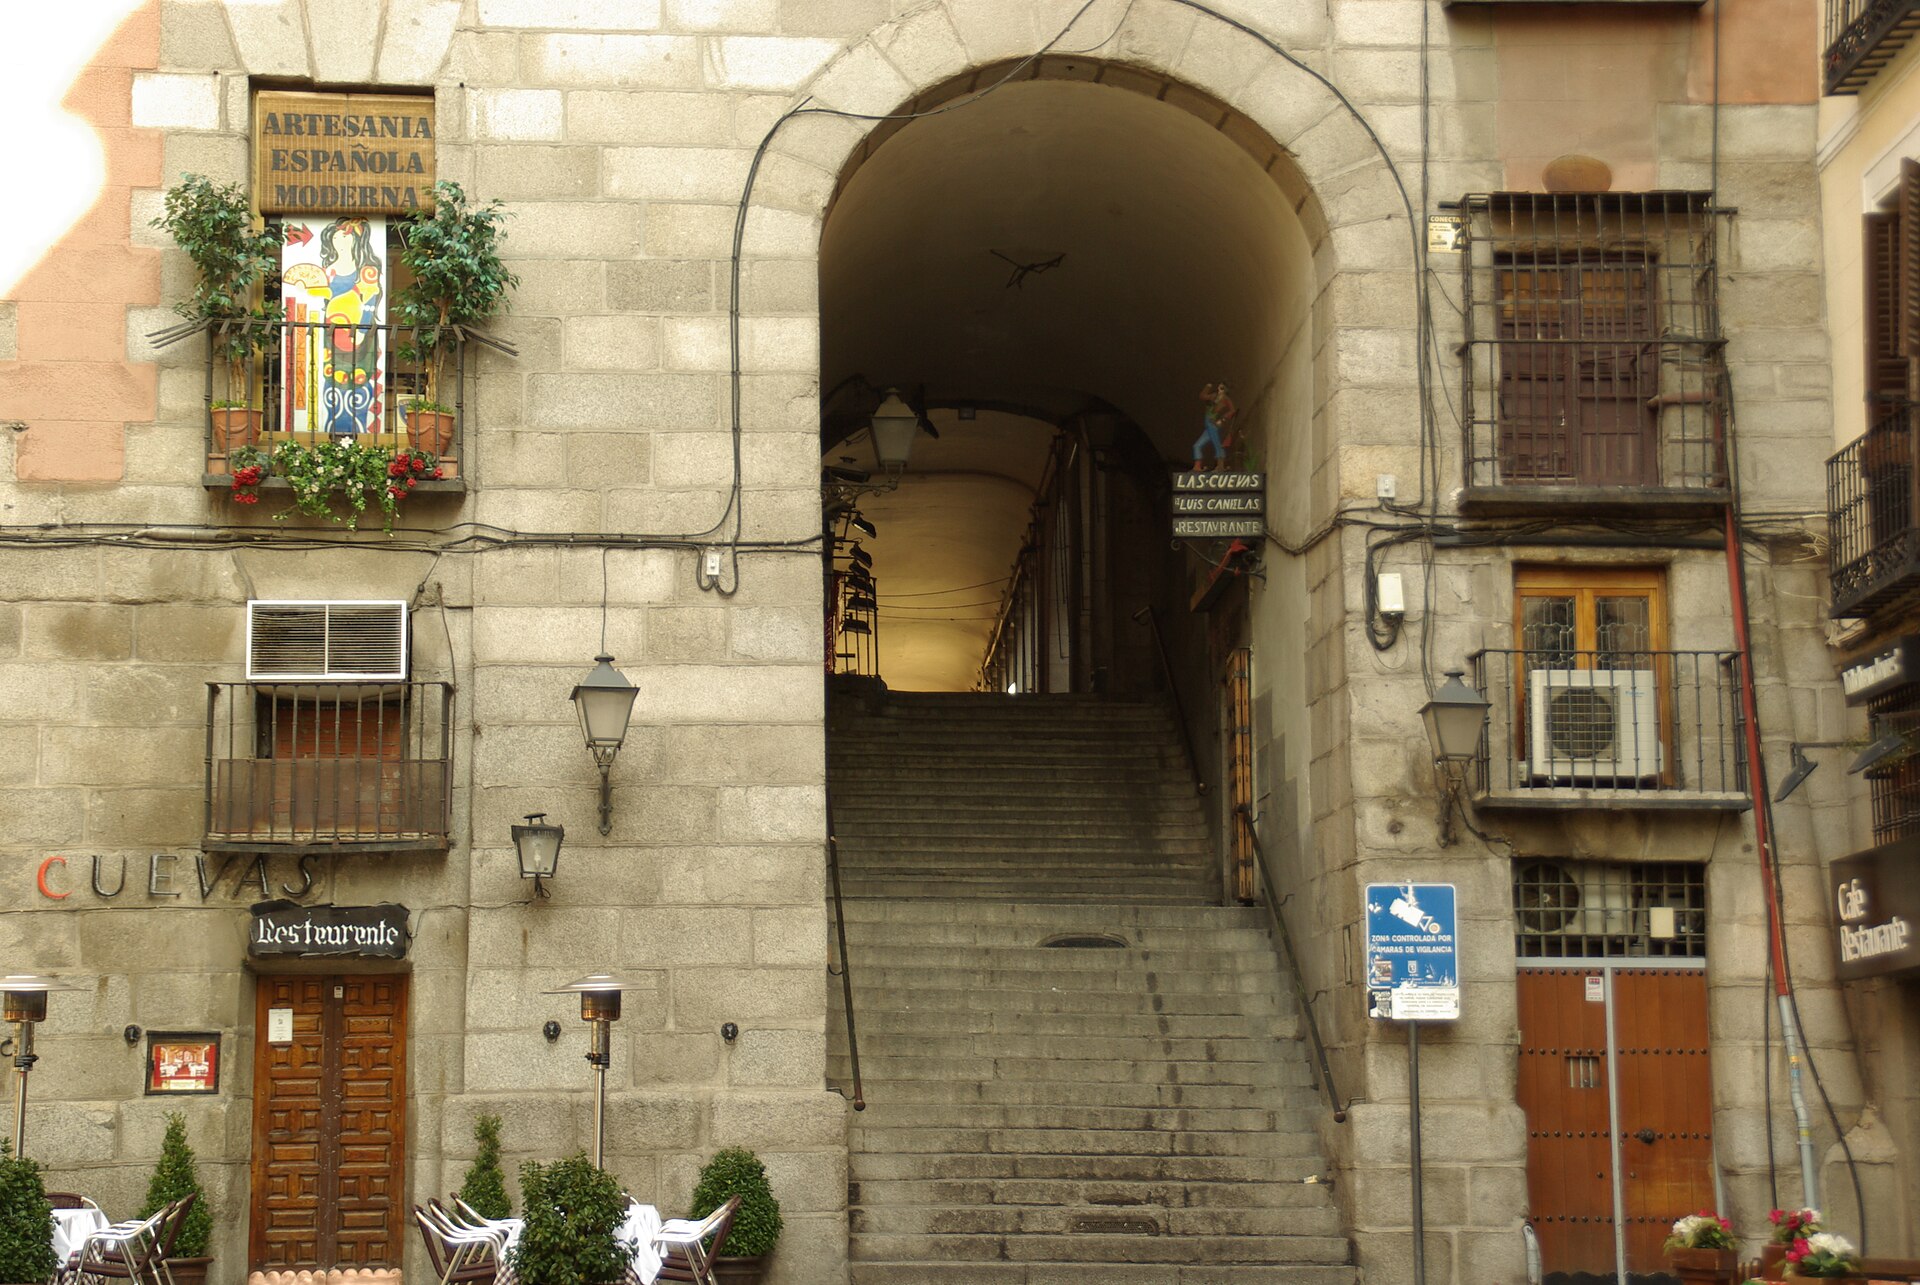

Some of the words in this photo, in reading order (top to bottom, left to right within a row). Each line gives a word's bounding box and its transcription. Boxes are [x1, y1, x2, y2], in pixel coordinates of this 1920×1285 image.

[263, 112, 432, 138] ARTESANIA
[271, 143, 424, 174] ESPAÑOLA
[275, 184, 419, 208] MODERNA
[37, 853, 317, 900] CUEVAS
[1371, 934, 1390, 942] ZONA
[1391, 934, 1436, 942] CONTROLADA
[1437, 934, 1452, 942] POR
[1405, 945, 1415, 953] DE
[1416, 945, 1452, 953] VIGILANCIA
[1840, 916, 1909, 962] Restaurante
